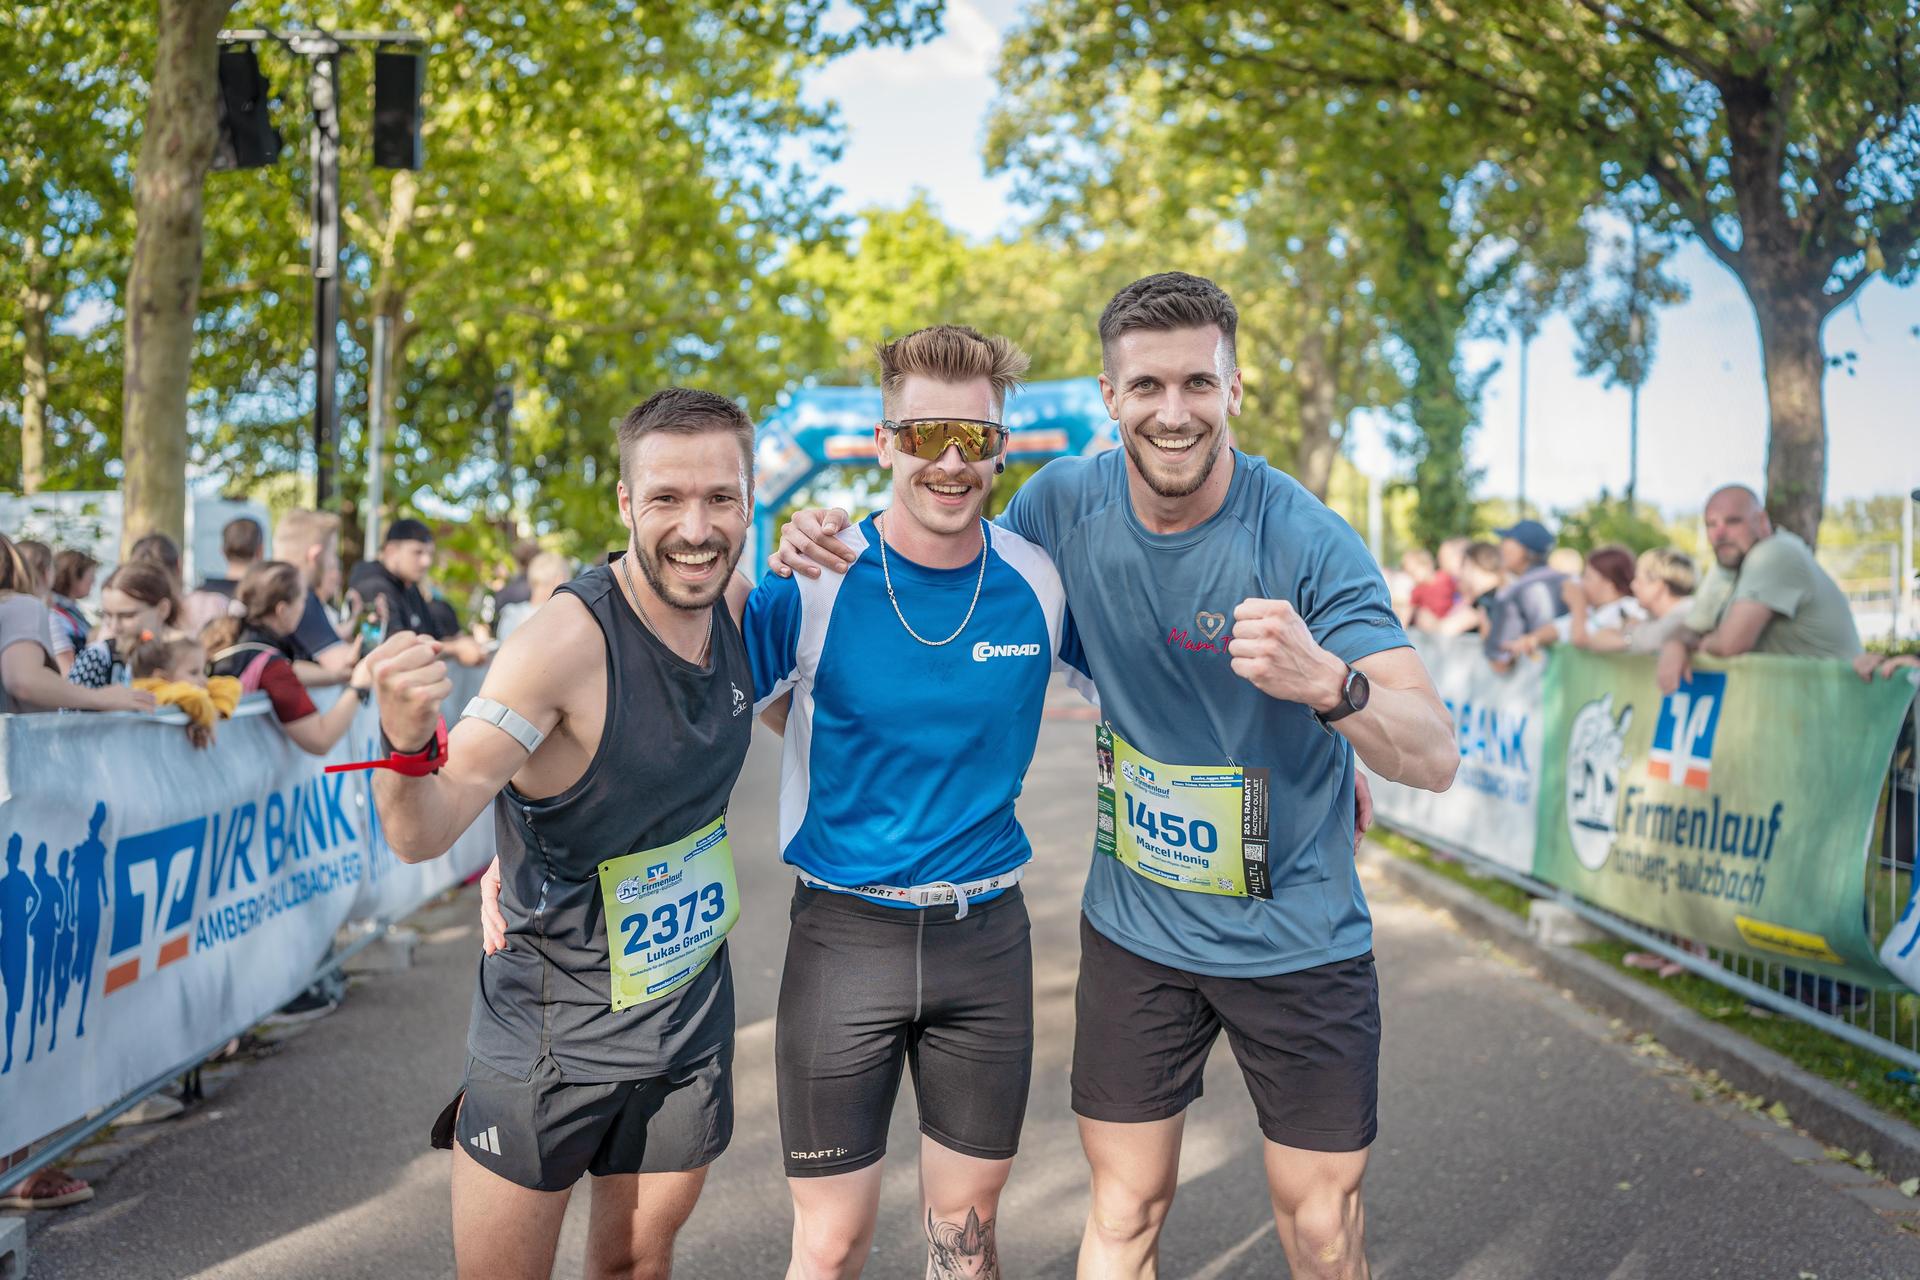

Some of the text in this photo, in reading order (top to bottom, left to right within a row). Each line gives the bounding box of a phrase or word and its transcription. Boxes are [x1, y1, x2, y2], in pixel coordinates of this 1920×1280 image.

[972, 641, 1041, 662] CONRAD
[1244, 777, 1252, 814] RABATT
[207, 801, 258, 898] VR
[264, 772, 357, 877] BANK
[1124, 791, 1218, 853] 1450
[1243, 823, 1251, 836] 20
[1624, 785, 1785, 863] Firmenlauf
[1136, 834, 1171, 858] Marcel
[1173, 850, 1210, 869] Honig
[641, 869, 683, 893] Firmenlauf
[854, 885, 893, 897] SPORT
[1249, 863, 1262, 894] HILTL
[620, 882, 725, 956] 2373
[646, 943, 681, 964] Lukas
[682, 925, 713, 949] Graml
[790, 1149, 834, 1159] CRAFT
